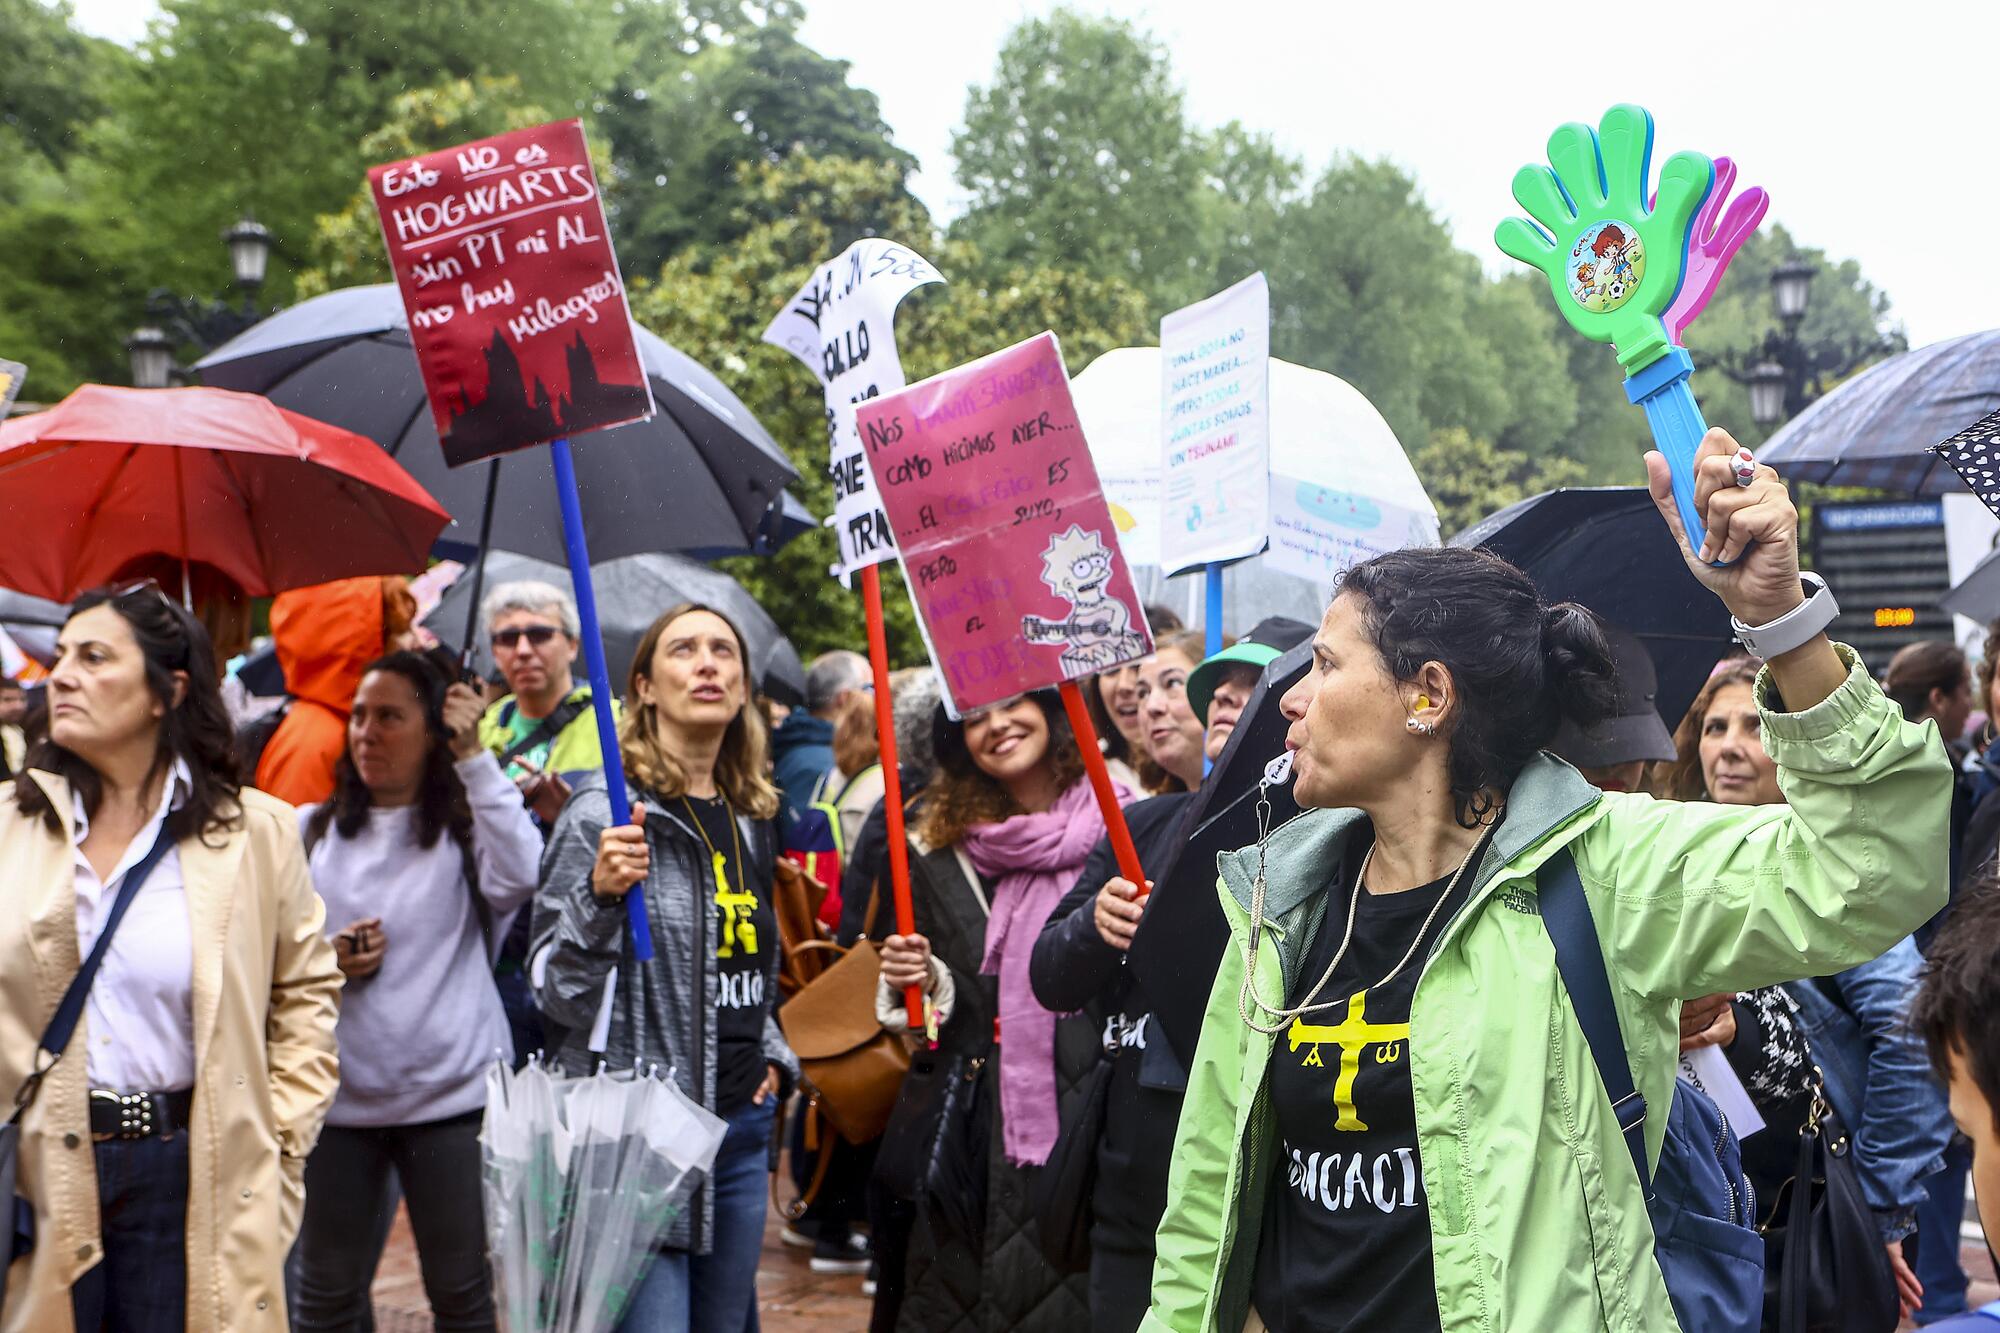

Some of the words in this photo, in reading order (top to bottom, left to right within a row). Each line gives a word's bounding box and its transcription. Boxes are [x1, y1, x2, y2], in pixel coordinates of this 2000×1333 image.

[382, 160, 442, 198] Esto
[457, 146, 500, 175] NO
[392, 164, 596, 241] HOGWARTS
[412, 252, 463, 288] sin
[458, 228, 505, 269] PT
[558, 215, 600, 250] AL
[413, 304, 455, 329] no
[461, 278, 515, 315] hay
[1229, 327, 1245, 344] NO
[886, 453, 932, 486] COMO
[1048, 456, 1071, 486] ES
[918, 554, 957, 588] PERO
[965, 616, 985, 634] EL
